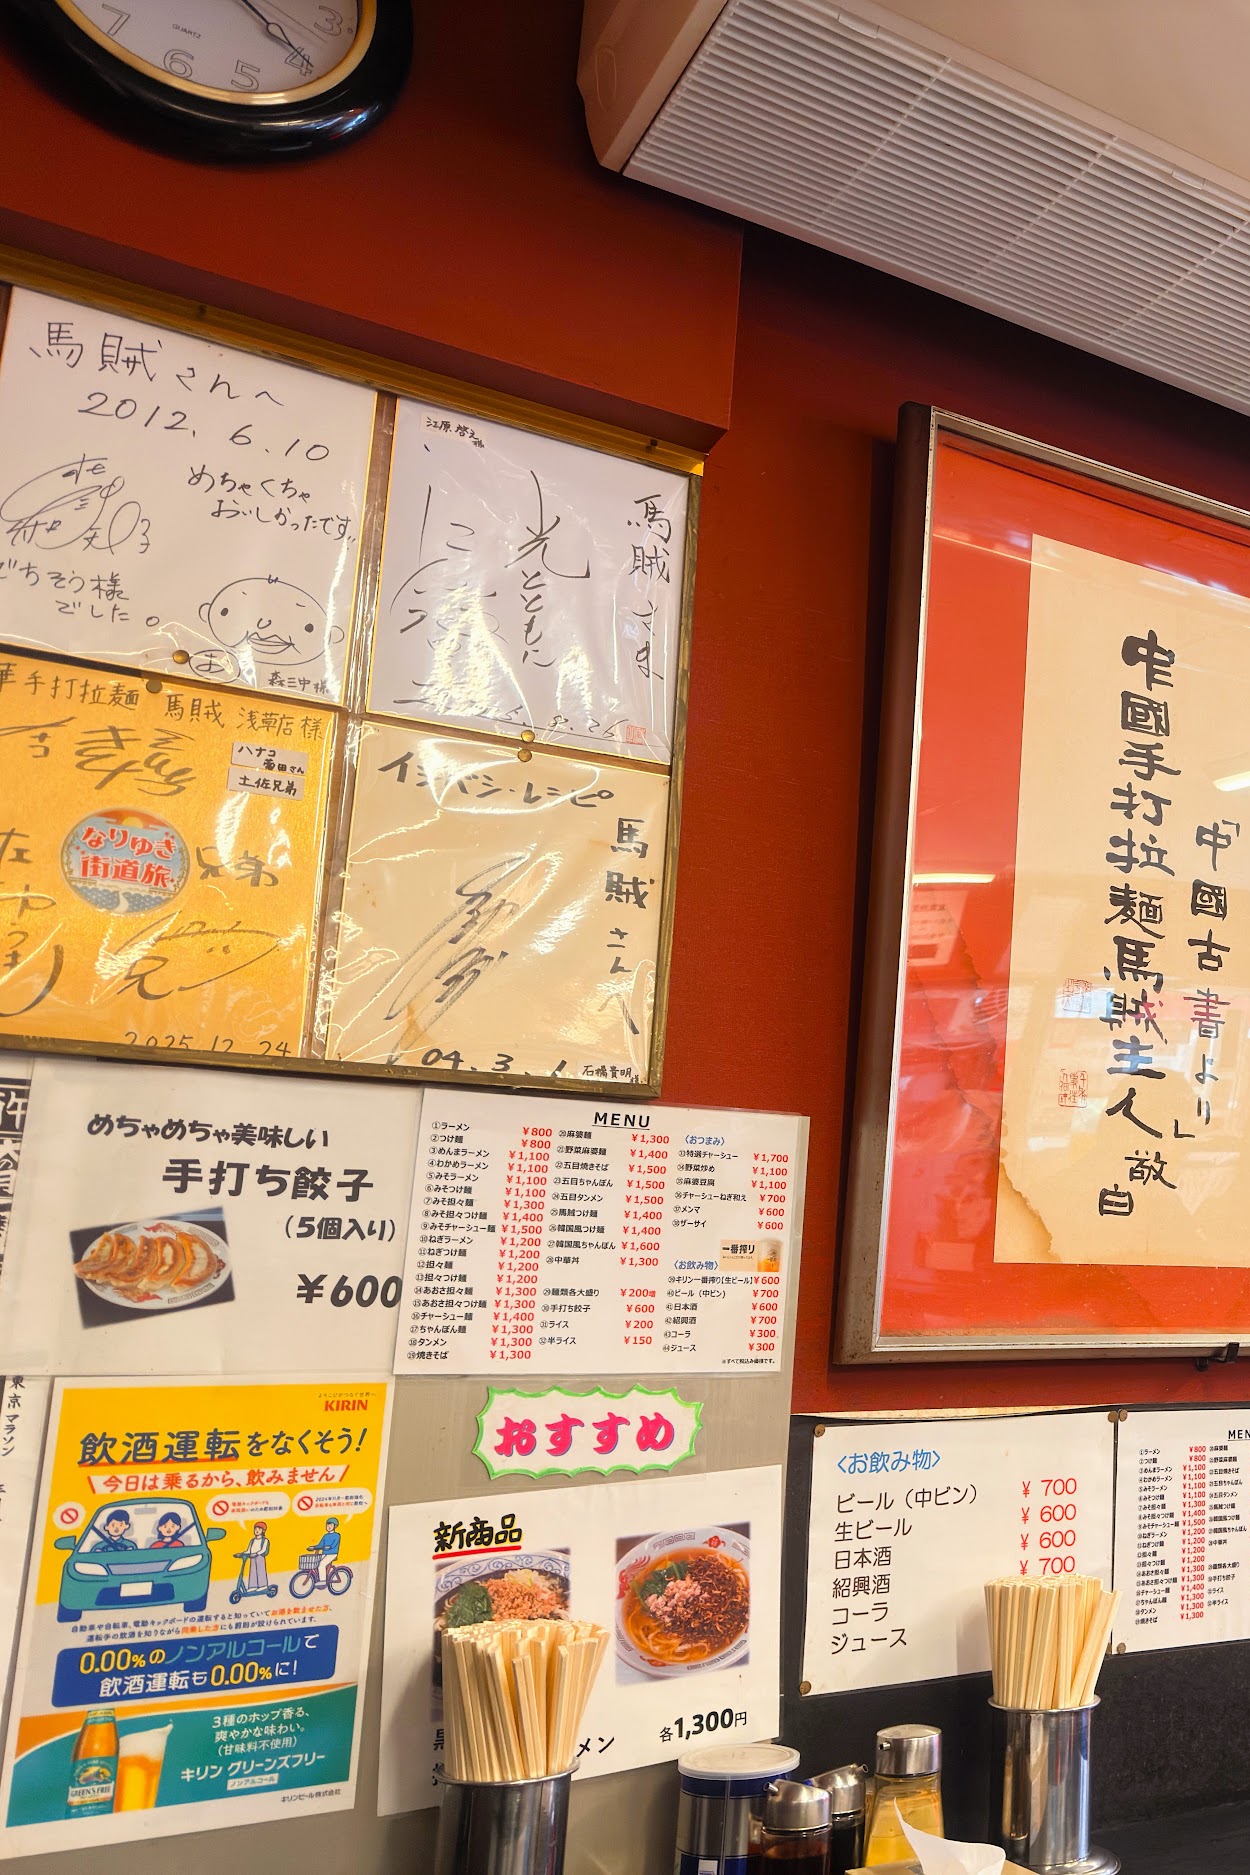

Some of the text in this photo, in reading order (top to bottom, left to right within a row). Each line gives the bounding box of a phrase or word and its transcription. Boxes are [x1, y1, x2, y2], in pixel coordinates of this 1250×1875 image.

[101, 3, 130, 36] 7
[172, 23, 201, 38] QUARTZ
[314, 6, 342, 36] 3
[164, 49, 194, 78] 6
[284, 46, 314, 76] 4
[231, 60, 260, 91] 5
[82, 825, 177, 861] なりゆき
[80, 853, 174, 889] 街道旅
[87, 1113, 329, 1148] めちゃめちゃ美味しい
[594, 1112, 650, 1127] MENU
[522, 1139, 550, 1149] ¥800
[523, 1127, 552, 1137] ¥800
[508, 1163, 548, 1173] ¥1,100
[509, 1151, 549, 1161] ¥1,100
[754, 1153, 788, 1163] ¥1,700
[162, 1159, 374, 1202] 手打ち餃子
[629, 1165, 666, 1174] ¥1,500
[503, 1212, 543, 1222] ¥1,400
[504, 1200, 544, 1210] ¥1,300
[759, 1208, 784, 1216] ¥600
[502, 1225, 542, 1235] ¥1,500
[758, 1222, 783, 1230] ¥600
[501, 1237, 541, 1247] ¥1,200
[297, 1274, 402, 1308] ¥600
[491, 1338, 532, 1348] ¥1,300
[749, 1343, 774, 1351] ¥300
[324, 1399, 368, 1411] KIRIN
[494, 1411, 675, 1457] おすすめ
[433, 1514, 522, 1553] 新商品
[834, 1518, 912, 1542] 生ビール
[834, 1546, 892, 1570] 日本酒
[832, 1574, 891, 1599] 紹興酒
[832, 1602, 889, 1626] コーラ
[831, 1628, 907, 1655] ジュース
[181, 1752, 326, 1782] キリン グリーンズフリー
